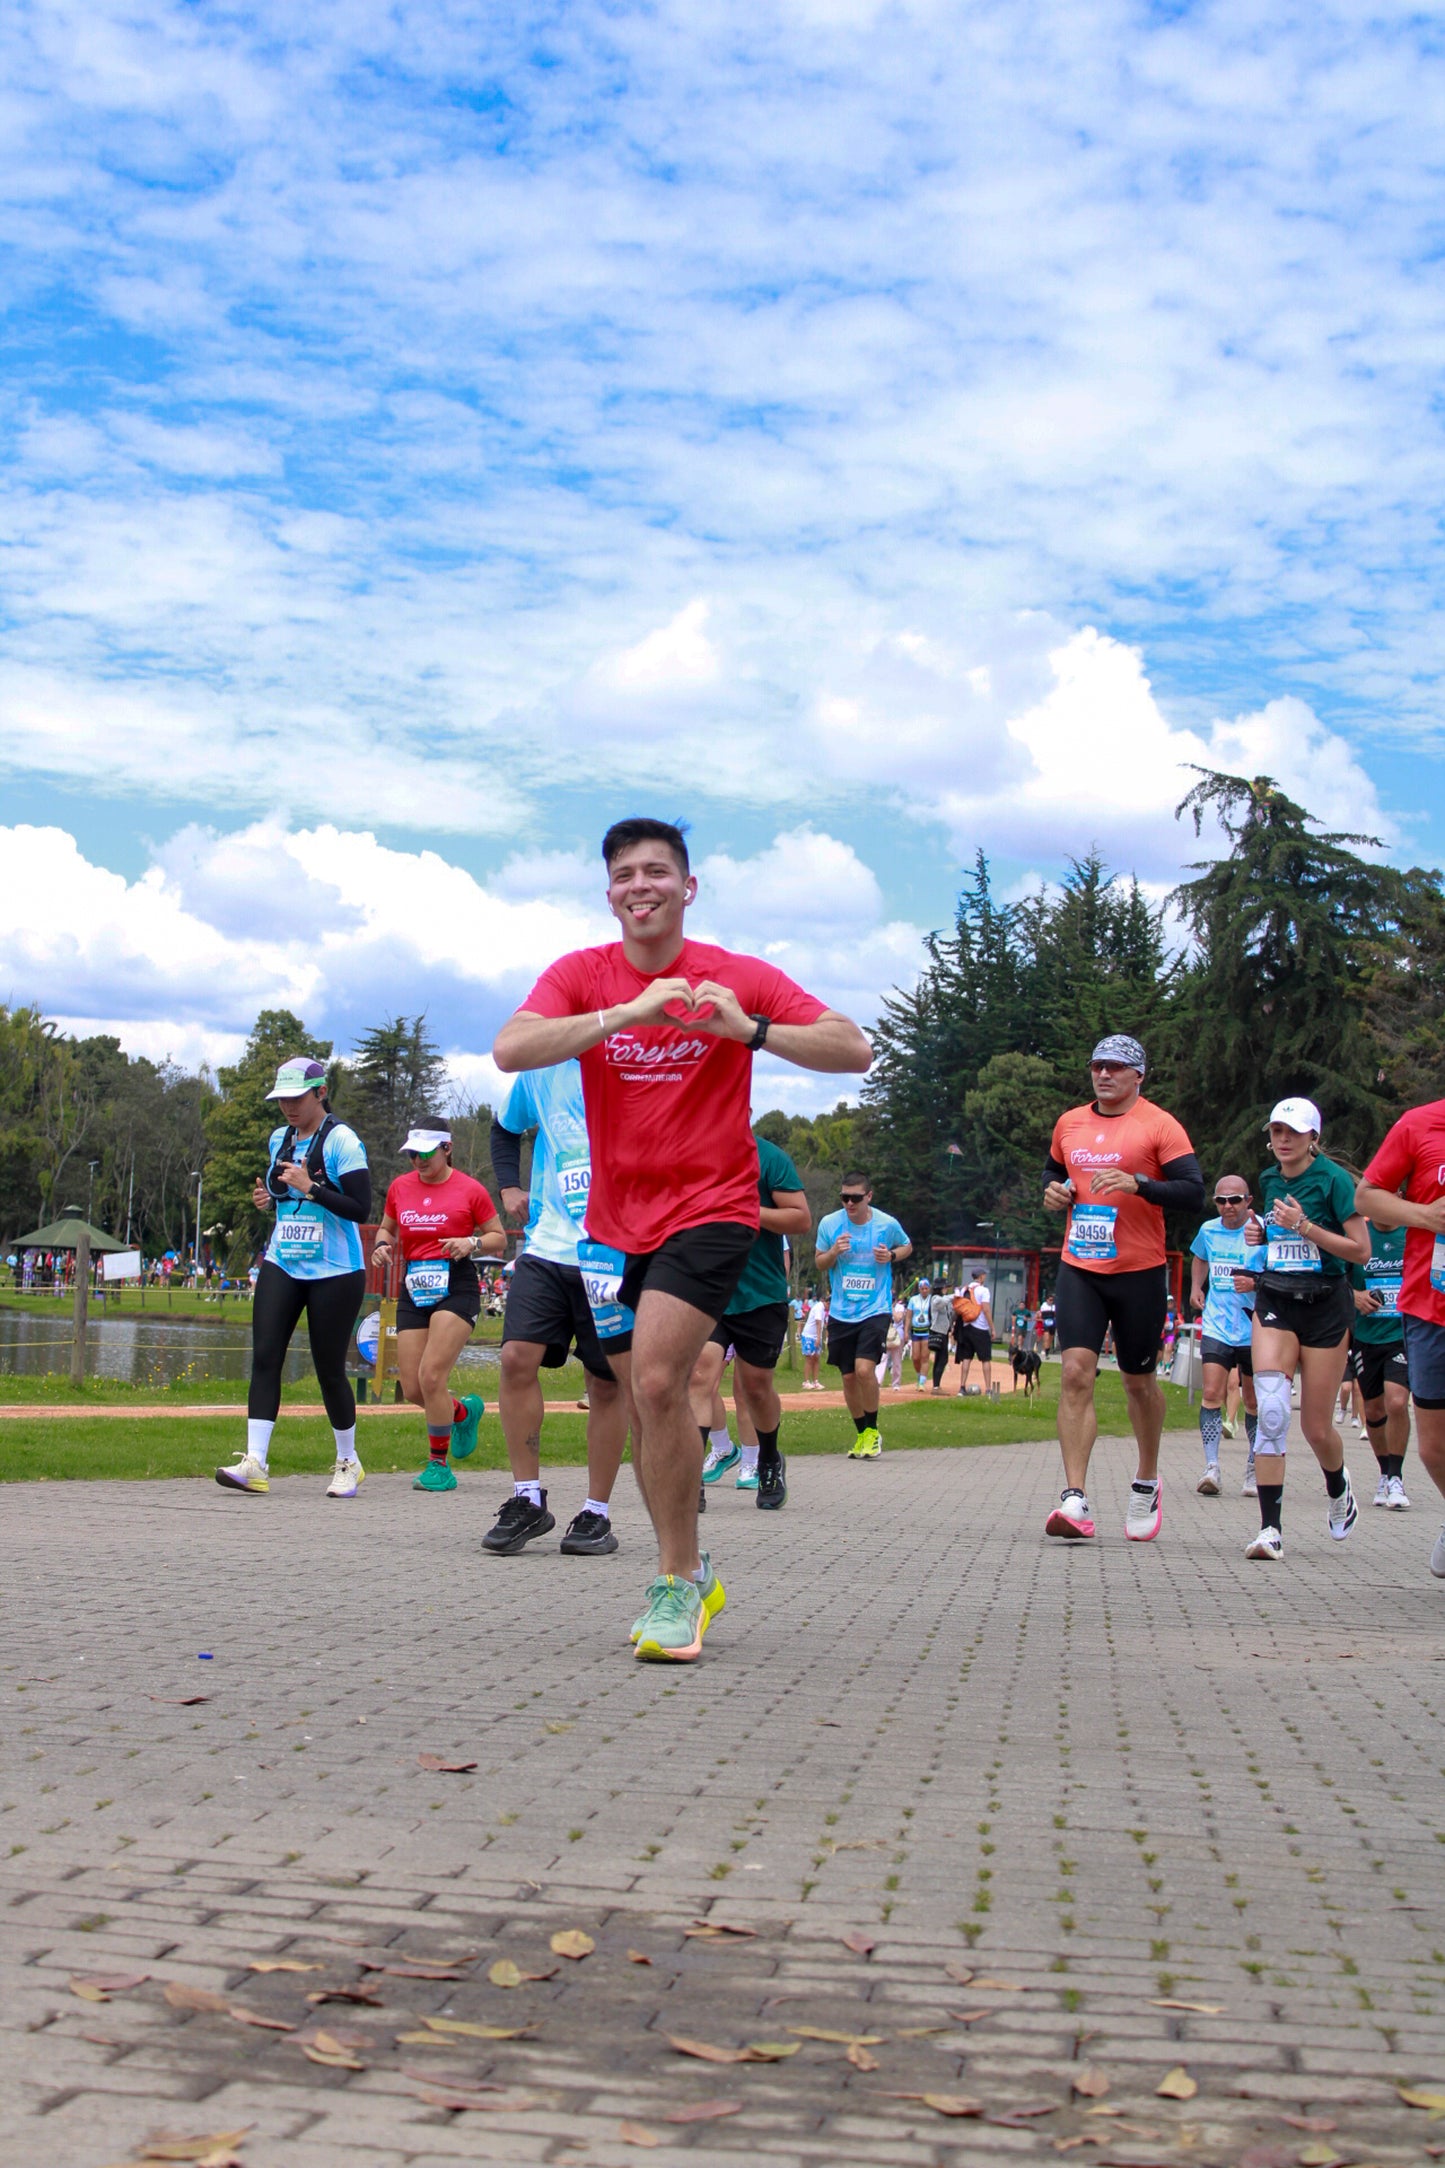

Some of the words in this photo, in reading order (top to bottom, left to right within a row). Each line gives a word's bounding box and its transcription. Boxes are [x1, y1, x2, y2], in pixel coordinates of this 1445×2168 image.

[605, 1032, 708, 1062] Forever
[1070, 1148, 1122, 1165] Forever
[400, 1210, 448, 1225] Forever
[281, 1225, 316, 1240] 10877
[1075, 1225, 1107, 1240] 19459
[1276, 1244, 1310, 1260] 17779
[410, 1275, 442, 1289] 14882
[846, 1279, 871, 1289] 20877
